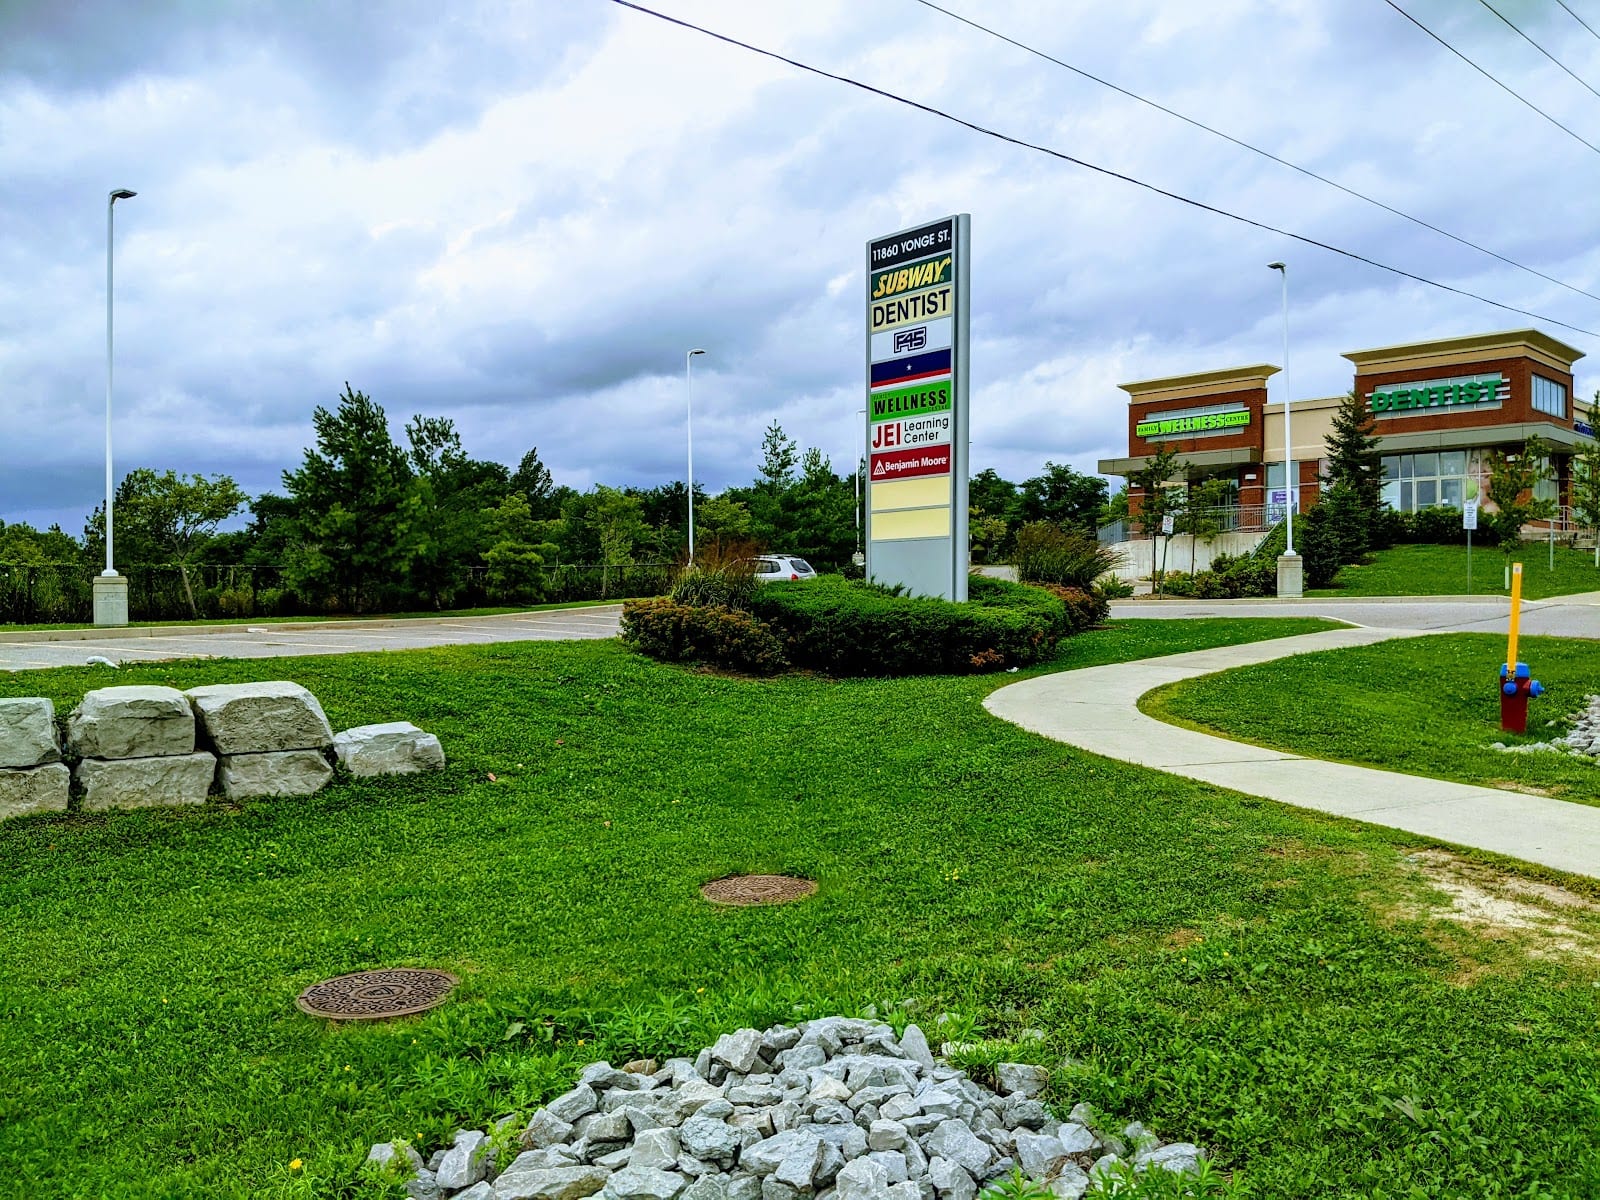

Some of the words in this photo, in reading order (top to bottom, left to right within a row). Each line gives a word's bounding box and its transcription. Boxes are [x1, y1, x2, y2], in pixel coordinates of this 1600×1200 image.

[873, 244, 898, 262] 11860
[901, 233, 935, 253] YONGE
[938, 229, 951, 243] ST.
[872, 256, 951, 298] SUBWAY
[873, 289, 951, 327] DENTIST
[894, 326, 927, 353] F45
[874, 389, 947, 415] WELLNESS
[1371, 380, 1502, 412] DENTIST
[872, 423, 901, 449] JEI
[904, 417, 949, 432] Learning
[1160, 413, 1225, 434] WELLNESS
[904, 431, 939, 444] Center
[885, 459, 919, 472] Benjamin
[921, 457, 947, 467] Moore
